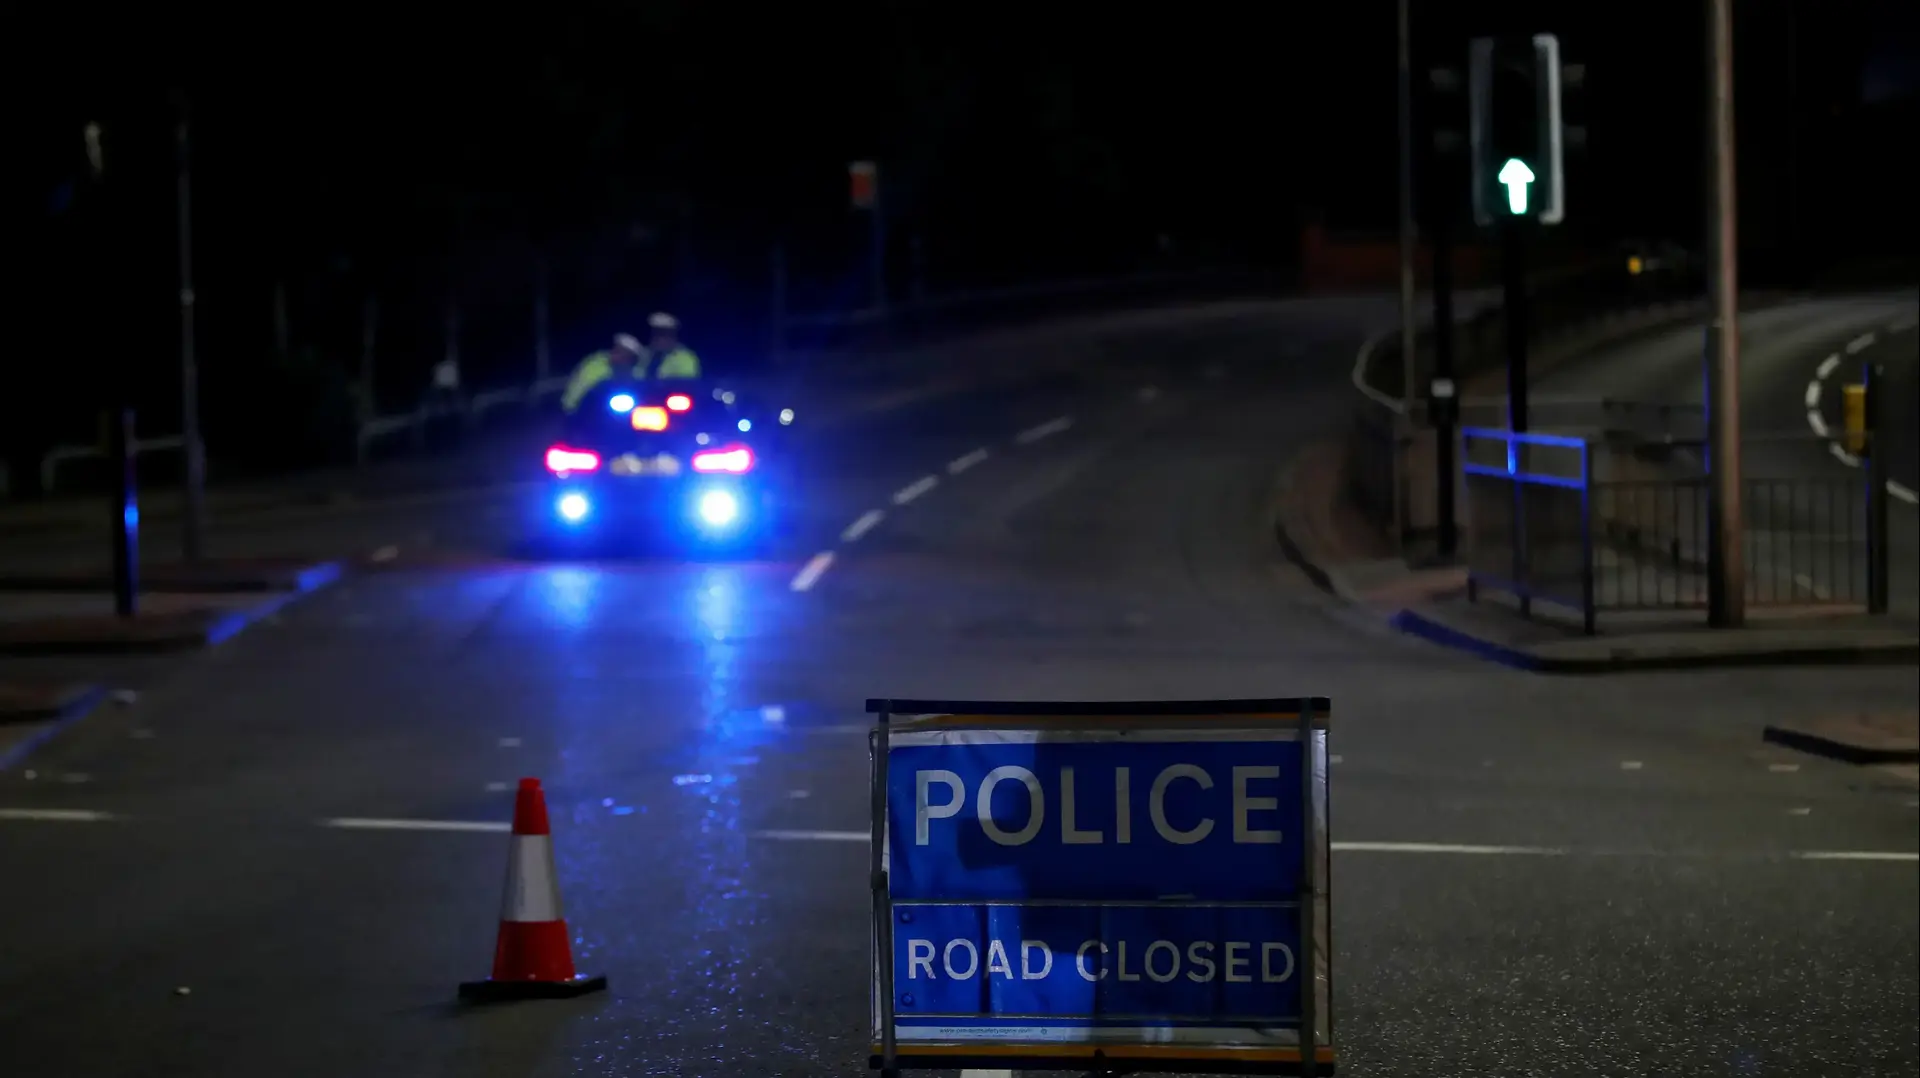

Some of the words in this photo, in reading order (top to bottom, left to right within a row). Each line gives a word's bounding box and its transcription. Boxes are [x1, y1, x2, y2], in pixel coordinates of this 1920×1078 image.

[915, 764, 1283, 846] POLICE
[907, 938, 1053, 981] ROAD
[1077, 939, 1296, 983] CLOSED
